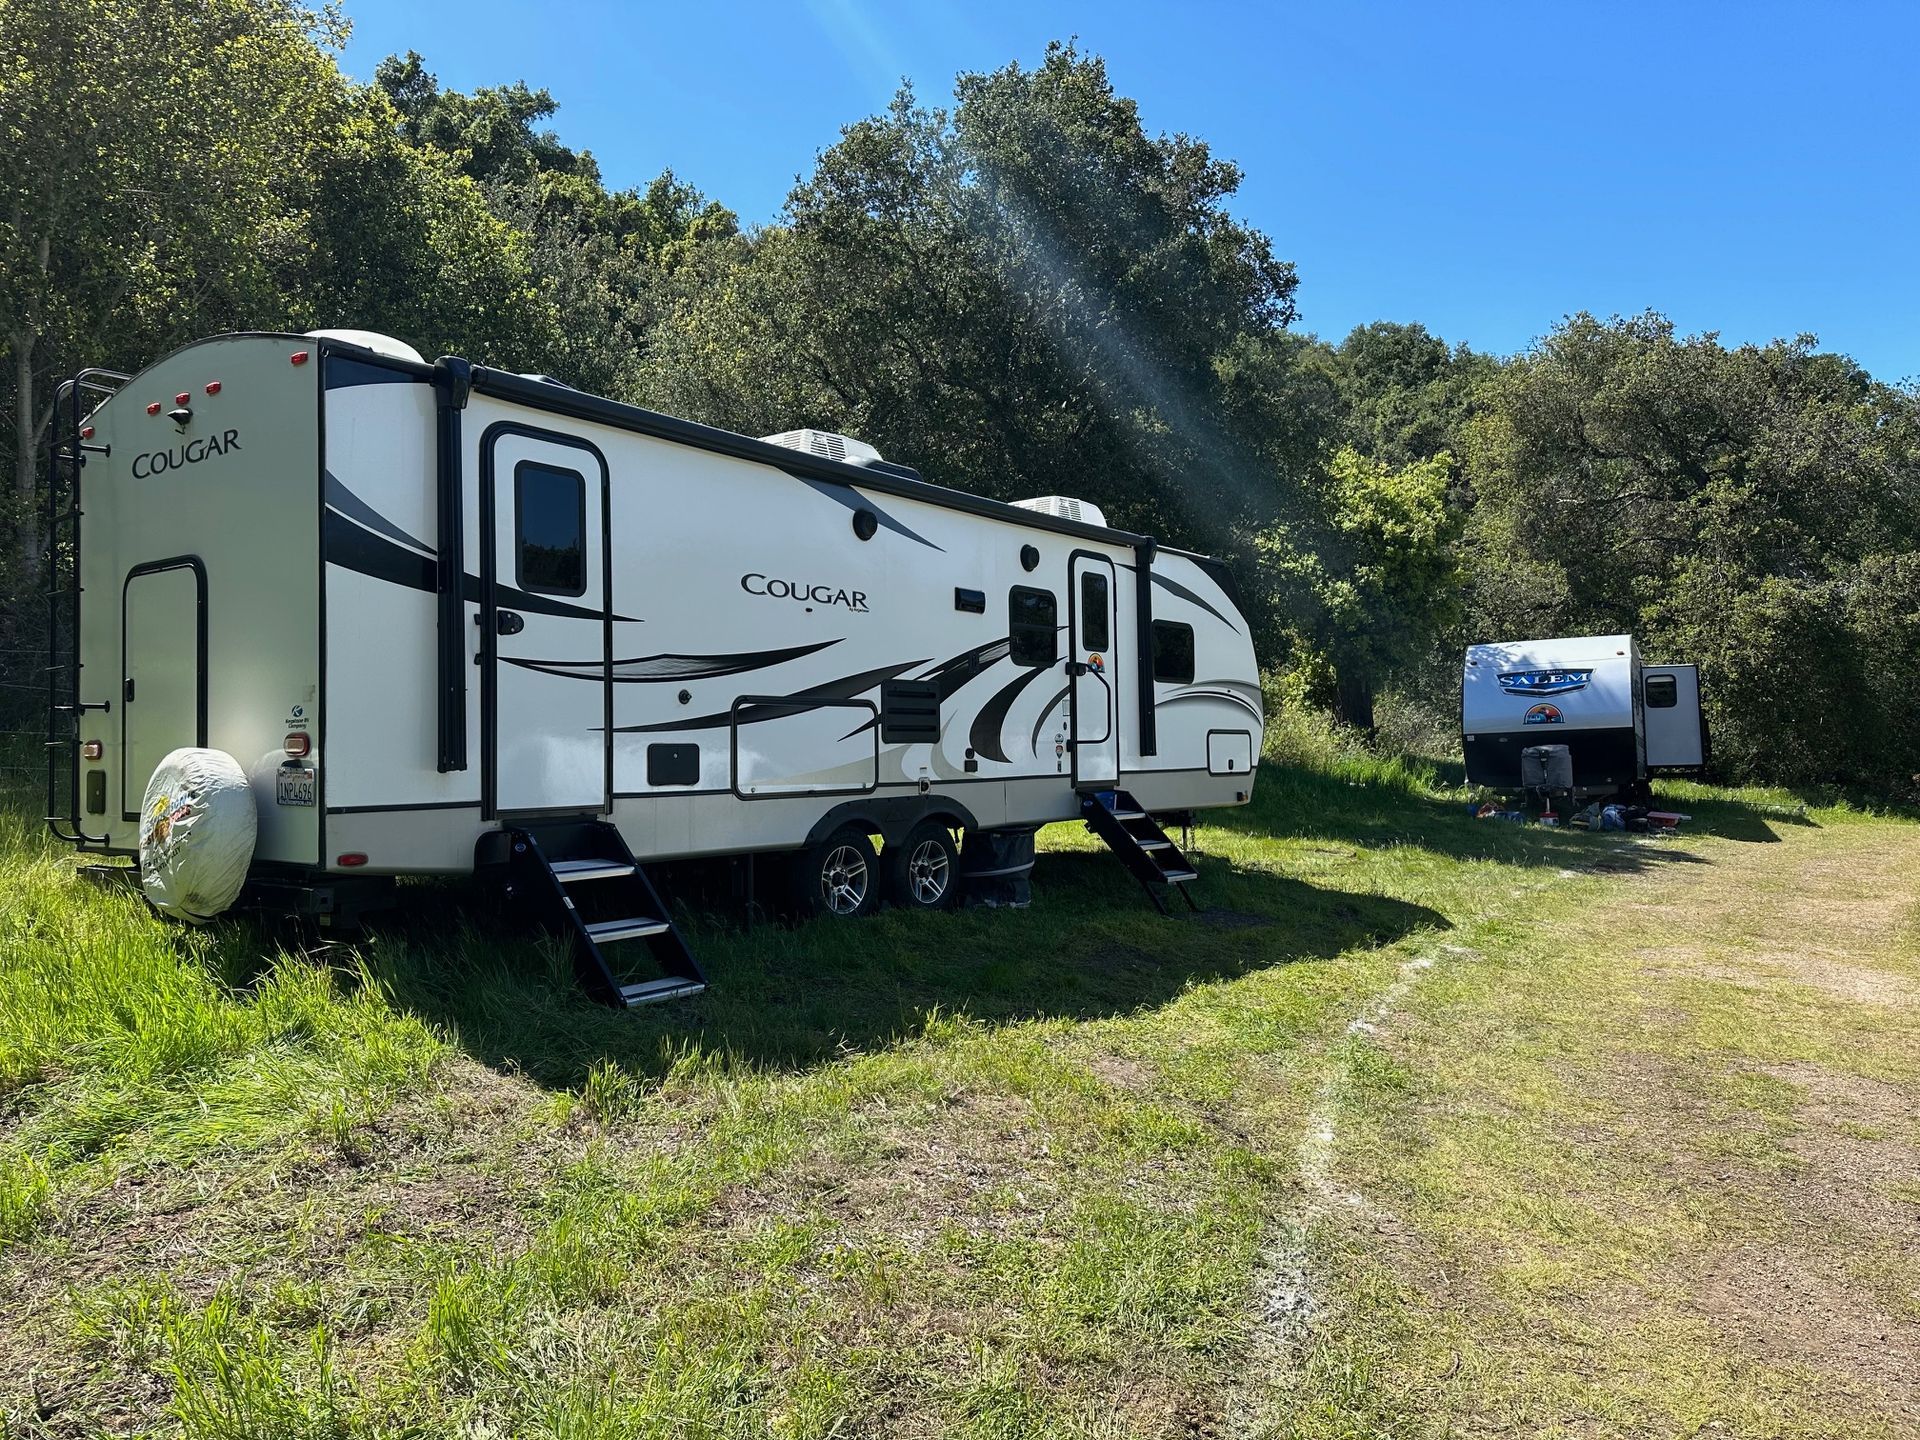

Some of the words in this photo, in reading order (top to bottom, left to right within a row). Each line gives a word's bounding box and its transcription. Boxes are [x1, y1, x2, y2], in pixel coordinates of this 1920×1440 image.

[132, 429, 242, 479] COUGAR
[740, 573, 869, 609] COUGAR
[1500, 673, 1589, 686] SALEM
[280, 782, 312, 800] 1NP4696
